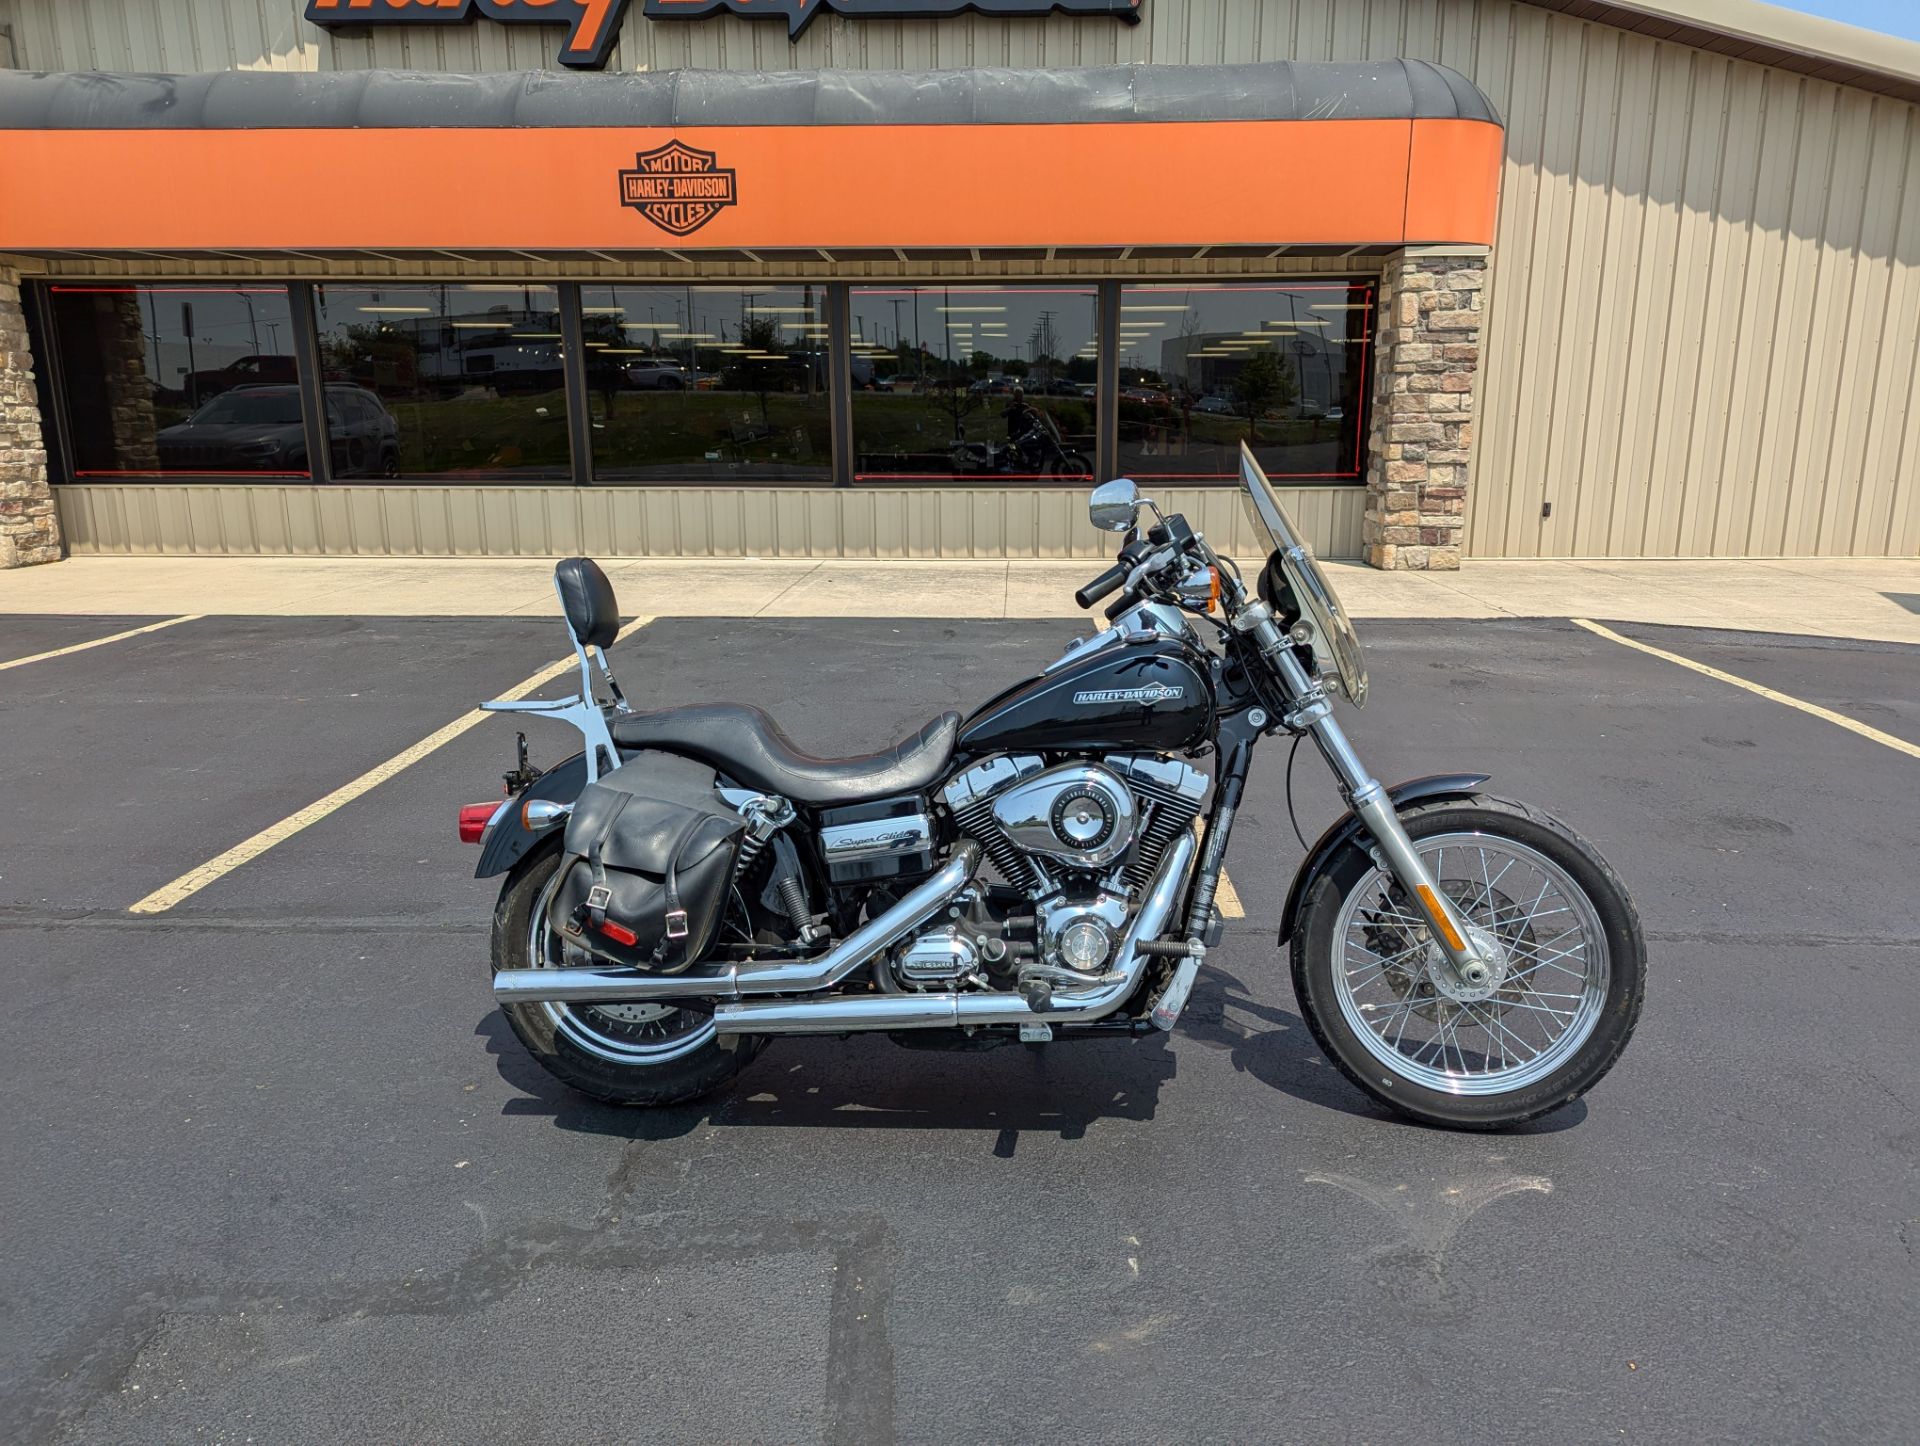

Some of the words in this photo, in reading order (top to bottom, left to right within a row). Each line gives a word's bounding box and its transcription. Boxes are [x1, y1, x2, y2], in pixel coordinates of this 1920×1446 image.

[650, 150, 703, 172] MOTOR
[628, 177, 728, 198] HARLEY-DAVIDSON
[653, 203, 705, 228] CYCLES
[1077, 688, 1180, 702] HARLEY-DAVIDSON
[834, 838, 875, 848] Super
